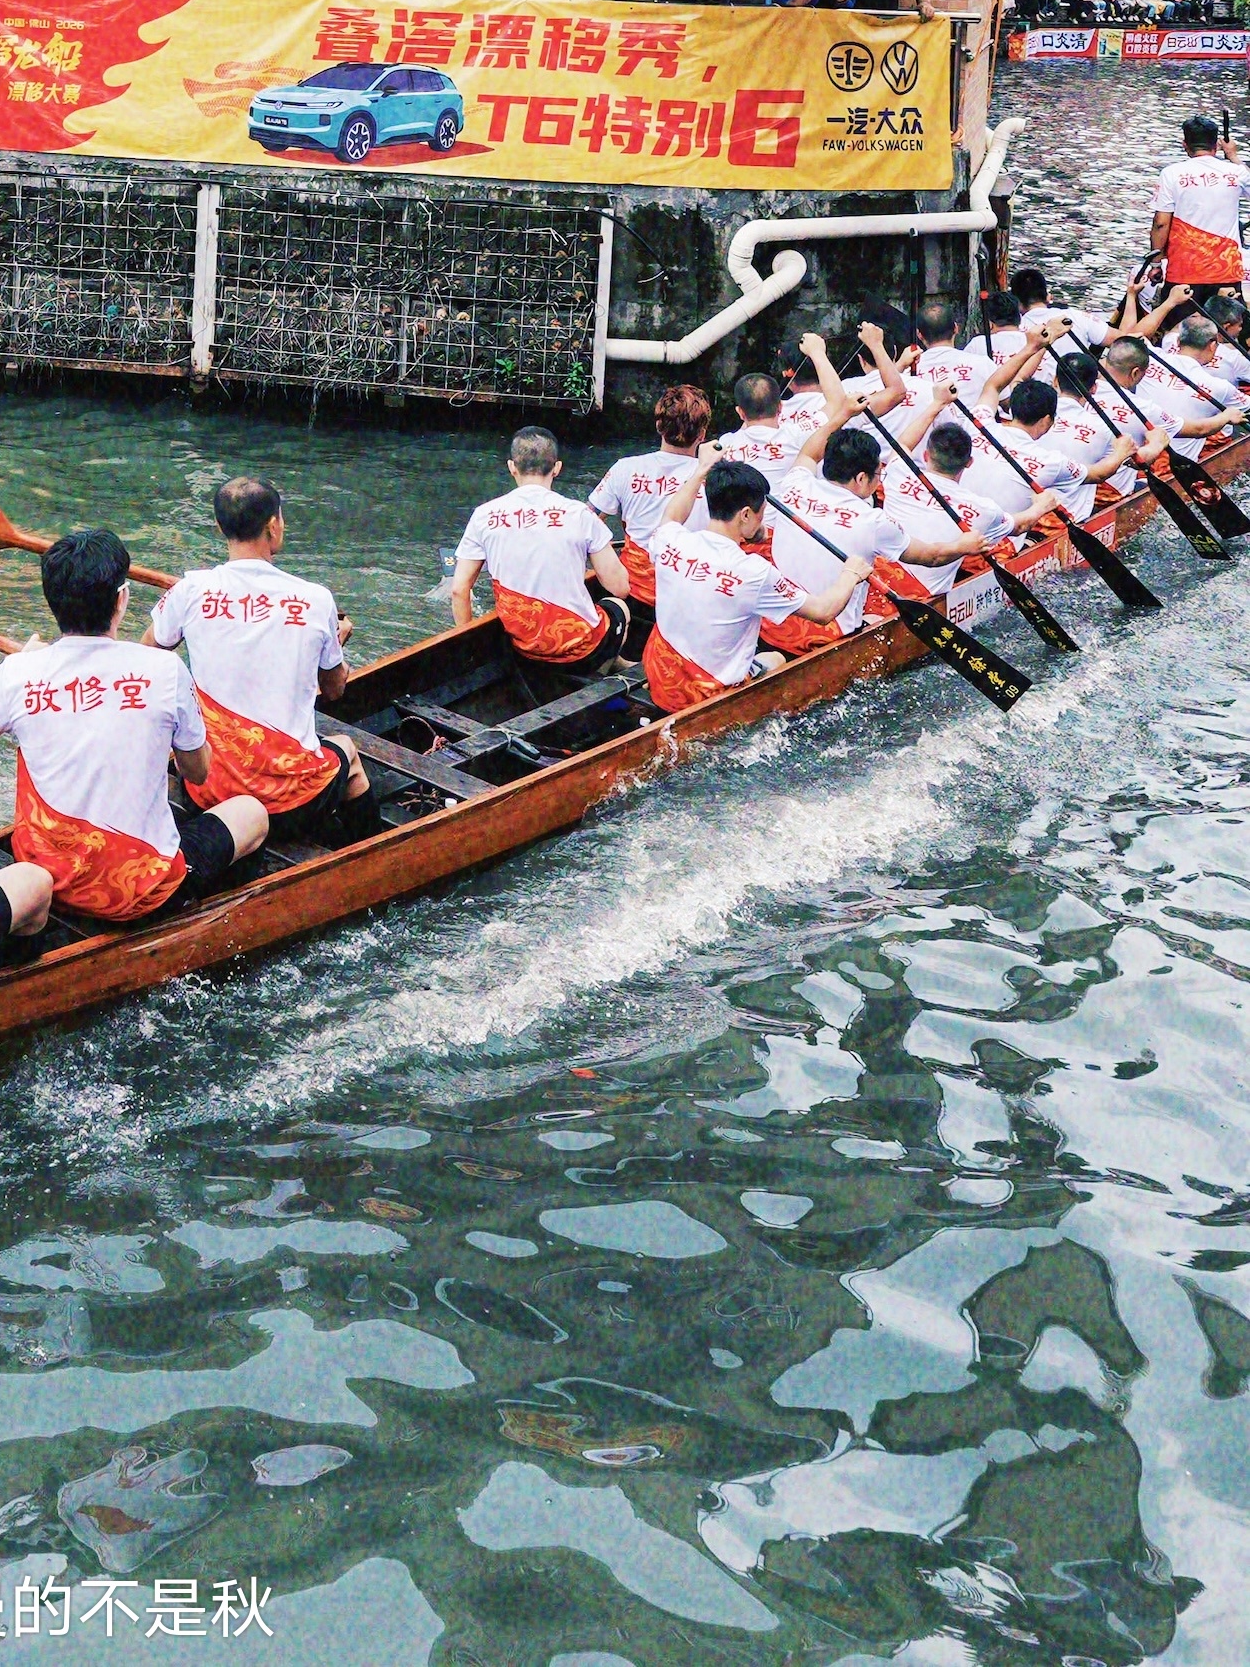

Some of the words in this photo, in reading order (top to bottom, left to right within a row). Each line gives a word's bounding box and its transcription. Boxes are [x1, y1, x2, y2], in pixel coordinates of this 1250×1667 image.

[55, 19, 85, 31] 2026
[7, 81, 82, 105] 漂移大赛
[477, 90, 805, 167] T6特别6
[822, 139, 923, 151] FAW-VOLKSWAGEN
[1178, 172, 1239, 187] 敬修堂
[487, 505, 568, 530] 敬修堂
[783, 485, 860, 530] 敬修堂
[660, 543, 743, 598] 敬修堂
[202, 588, 312, 627] 敬修堂
[23, 672, 152, 715] 敬修堂
[1004, 684, 1020, 699] 09
